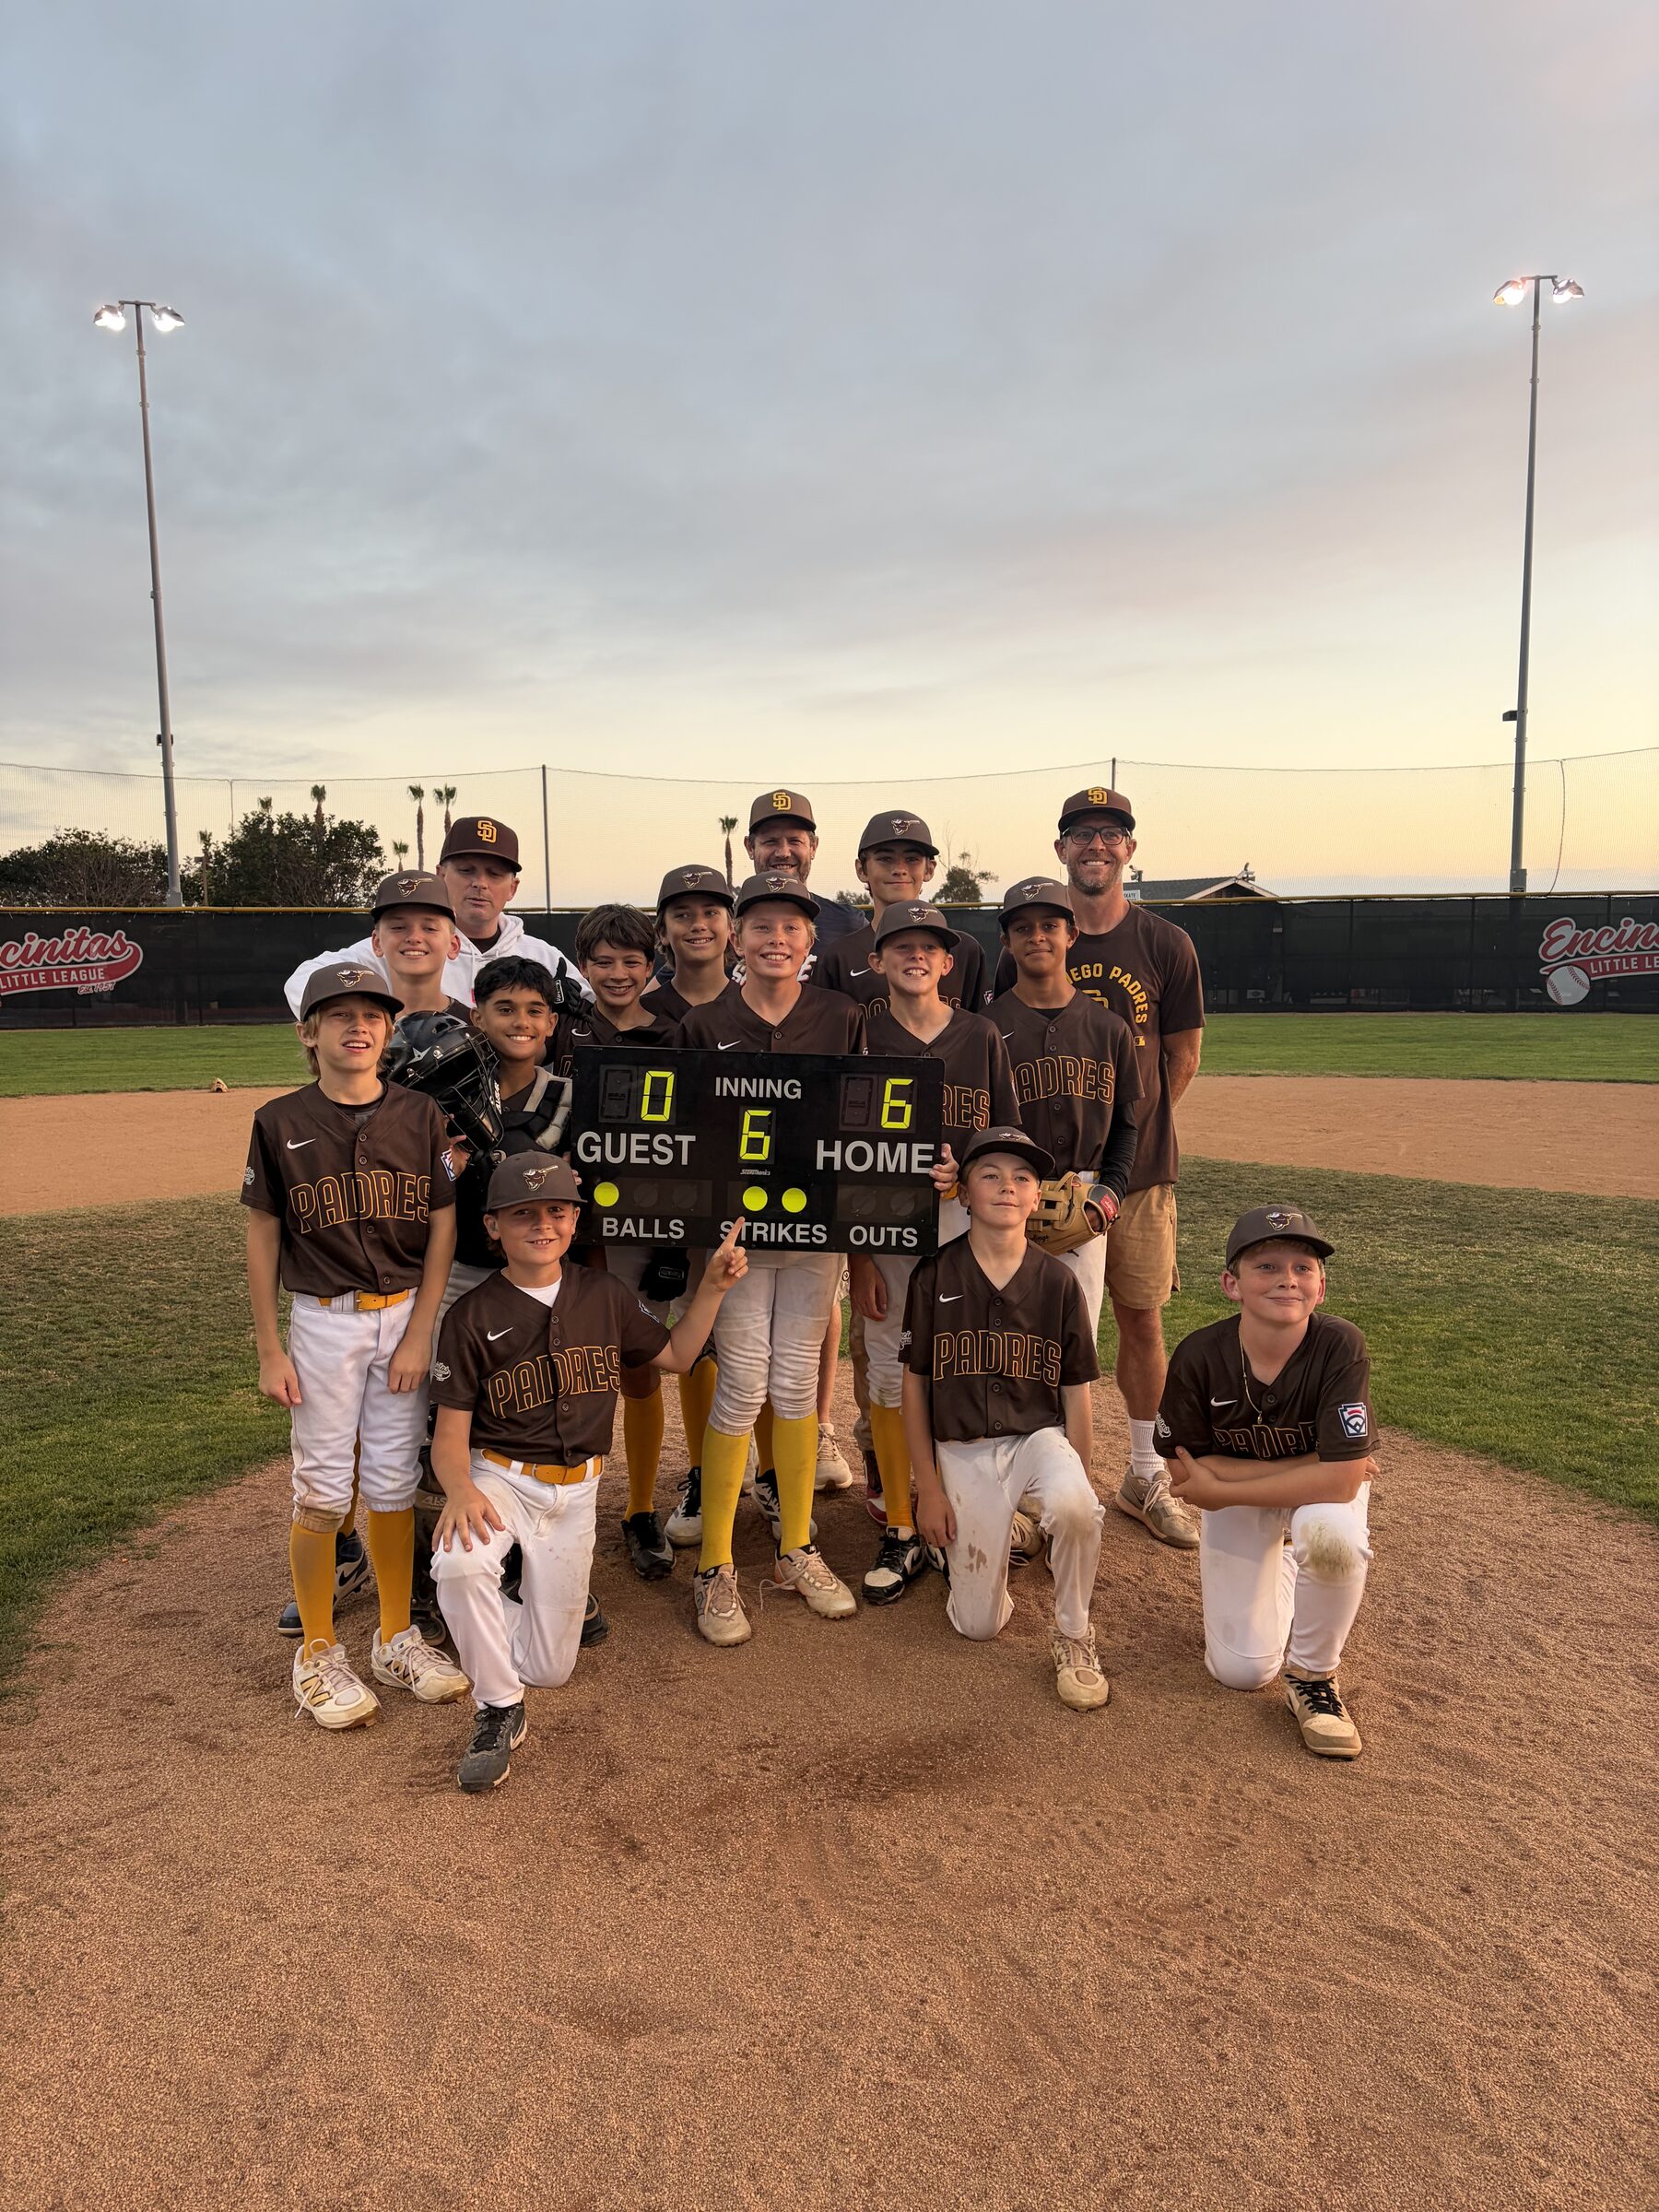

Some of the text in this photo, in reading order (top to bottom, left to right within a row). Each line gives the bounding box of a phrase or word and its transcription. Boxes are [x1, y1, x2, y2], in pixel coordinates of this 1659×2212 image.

[772, 792, 792, 811] SD
[1088, 787, 1108, 805] SD
[477, 819, 497, 843] SD
[0, 968, 105, 989] LITTLE LEAGUE
[1590, 958, 1639, 974] LITTLE
[1109, 966, 1148, 1024] PADRES
[641, 1071, 675, 1122] 0
[715, 1077, 802, 1100] INNING
[880, 1077, 914, 1129] 6
[577, 1131, 697, 1166] GUEST
[739, 1109, 773, 1160] 6
[817, 1139, 935, 1173] HOME
[289, 1170, 431, 1234] PADRES
[602, 1217, 685, 1240] BALLS
[719, 1220, 828, 1244] STRIKES
[849, 1225, 918, 1248] OUTS
[934, 1330, 1062, 1387] PADRES
[488, 1345, 621, 1419] PADRES
